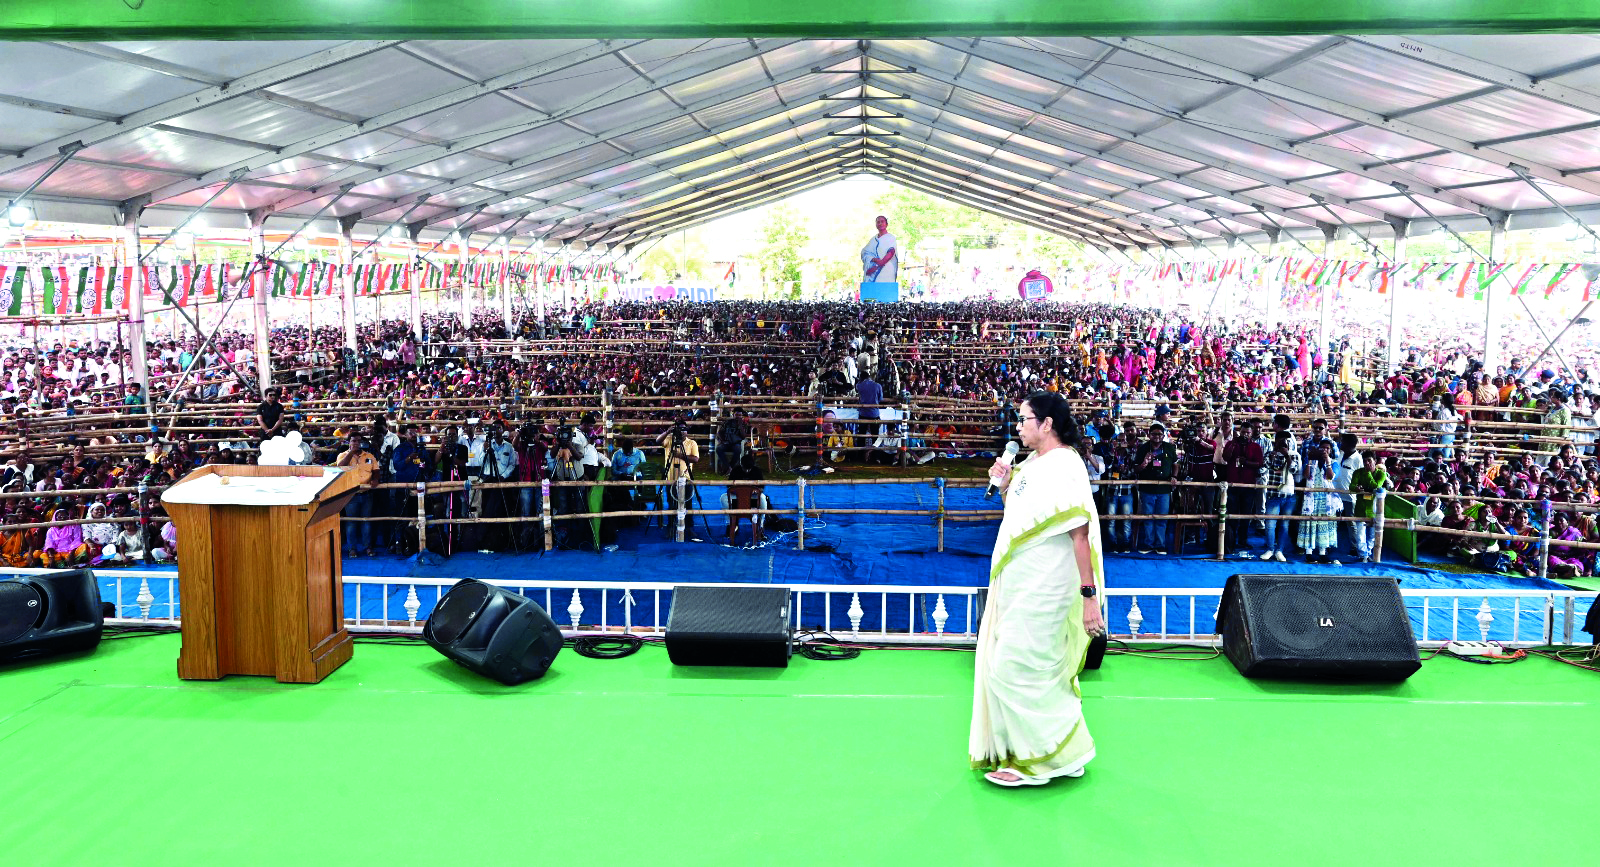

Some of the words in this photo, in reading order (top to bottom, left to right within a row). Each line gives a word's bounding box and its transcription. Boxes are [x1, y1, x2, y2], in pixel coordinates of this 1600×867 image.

[625, 288, 651, 300] WE
[678, 288, 714, 302] DIDI
[1320, 618, 1334, 627] LA
